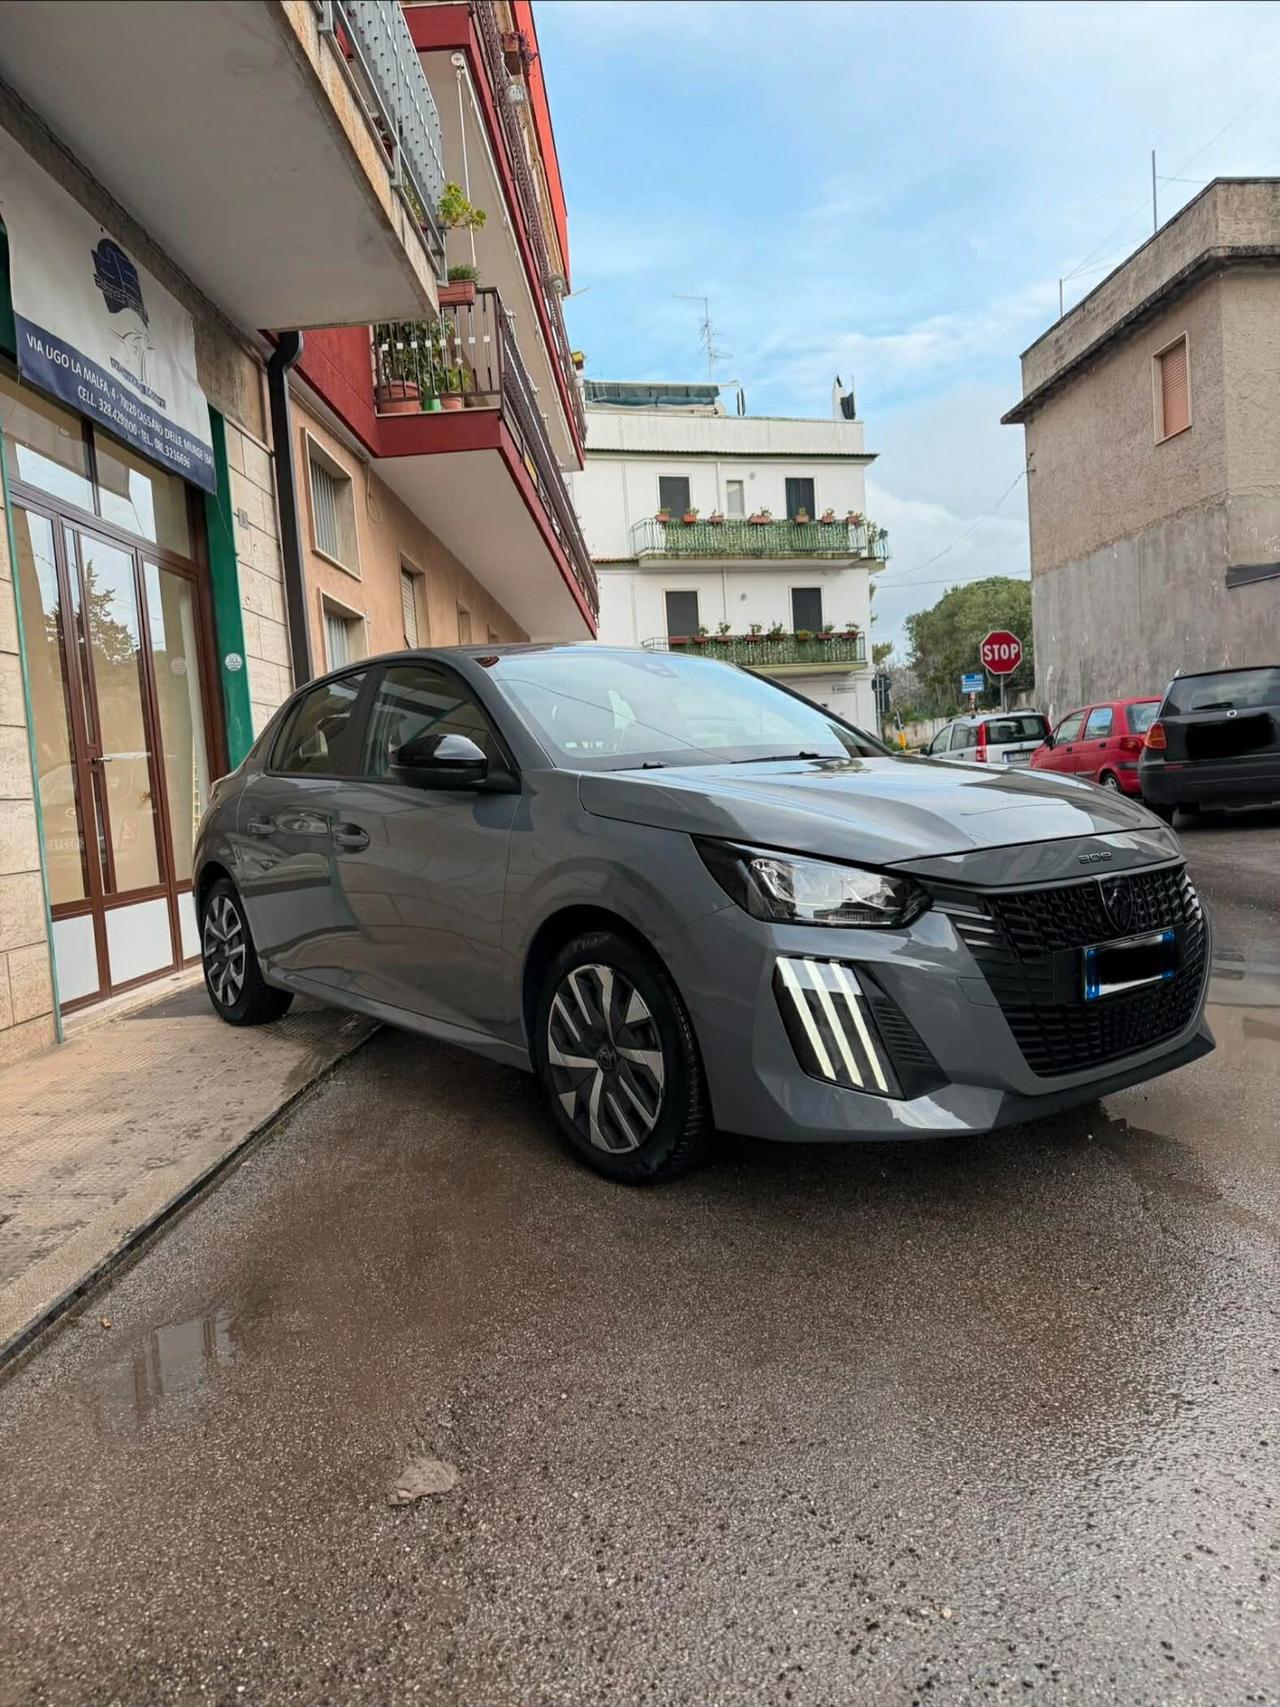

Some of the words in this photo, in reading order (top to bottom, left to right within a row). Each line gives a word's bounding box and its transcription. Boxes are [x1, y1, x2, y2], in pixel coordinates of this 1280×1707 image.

[26, 333, 44, 355] VIA
[45, 344, 70, 368] UGO
[71, 357, 82, 377] LA
[83, 367, 111, 397] MALFA,
[137, 408, 163, 436] CASSANO
[164, 427, 184, 447] DELLE
[77, 384, 97, 408] CELL.
[140, 429, 154, 447] TEL.
[984, 643, 1019, 661] STOP
